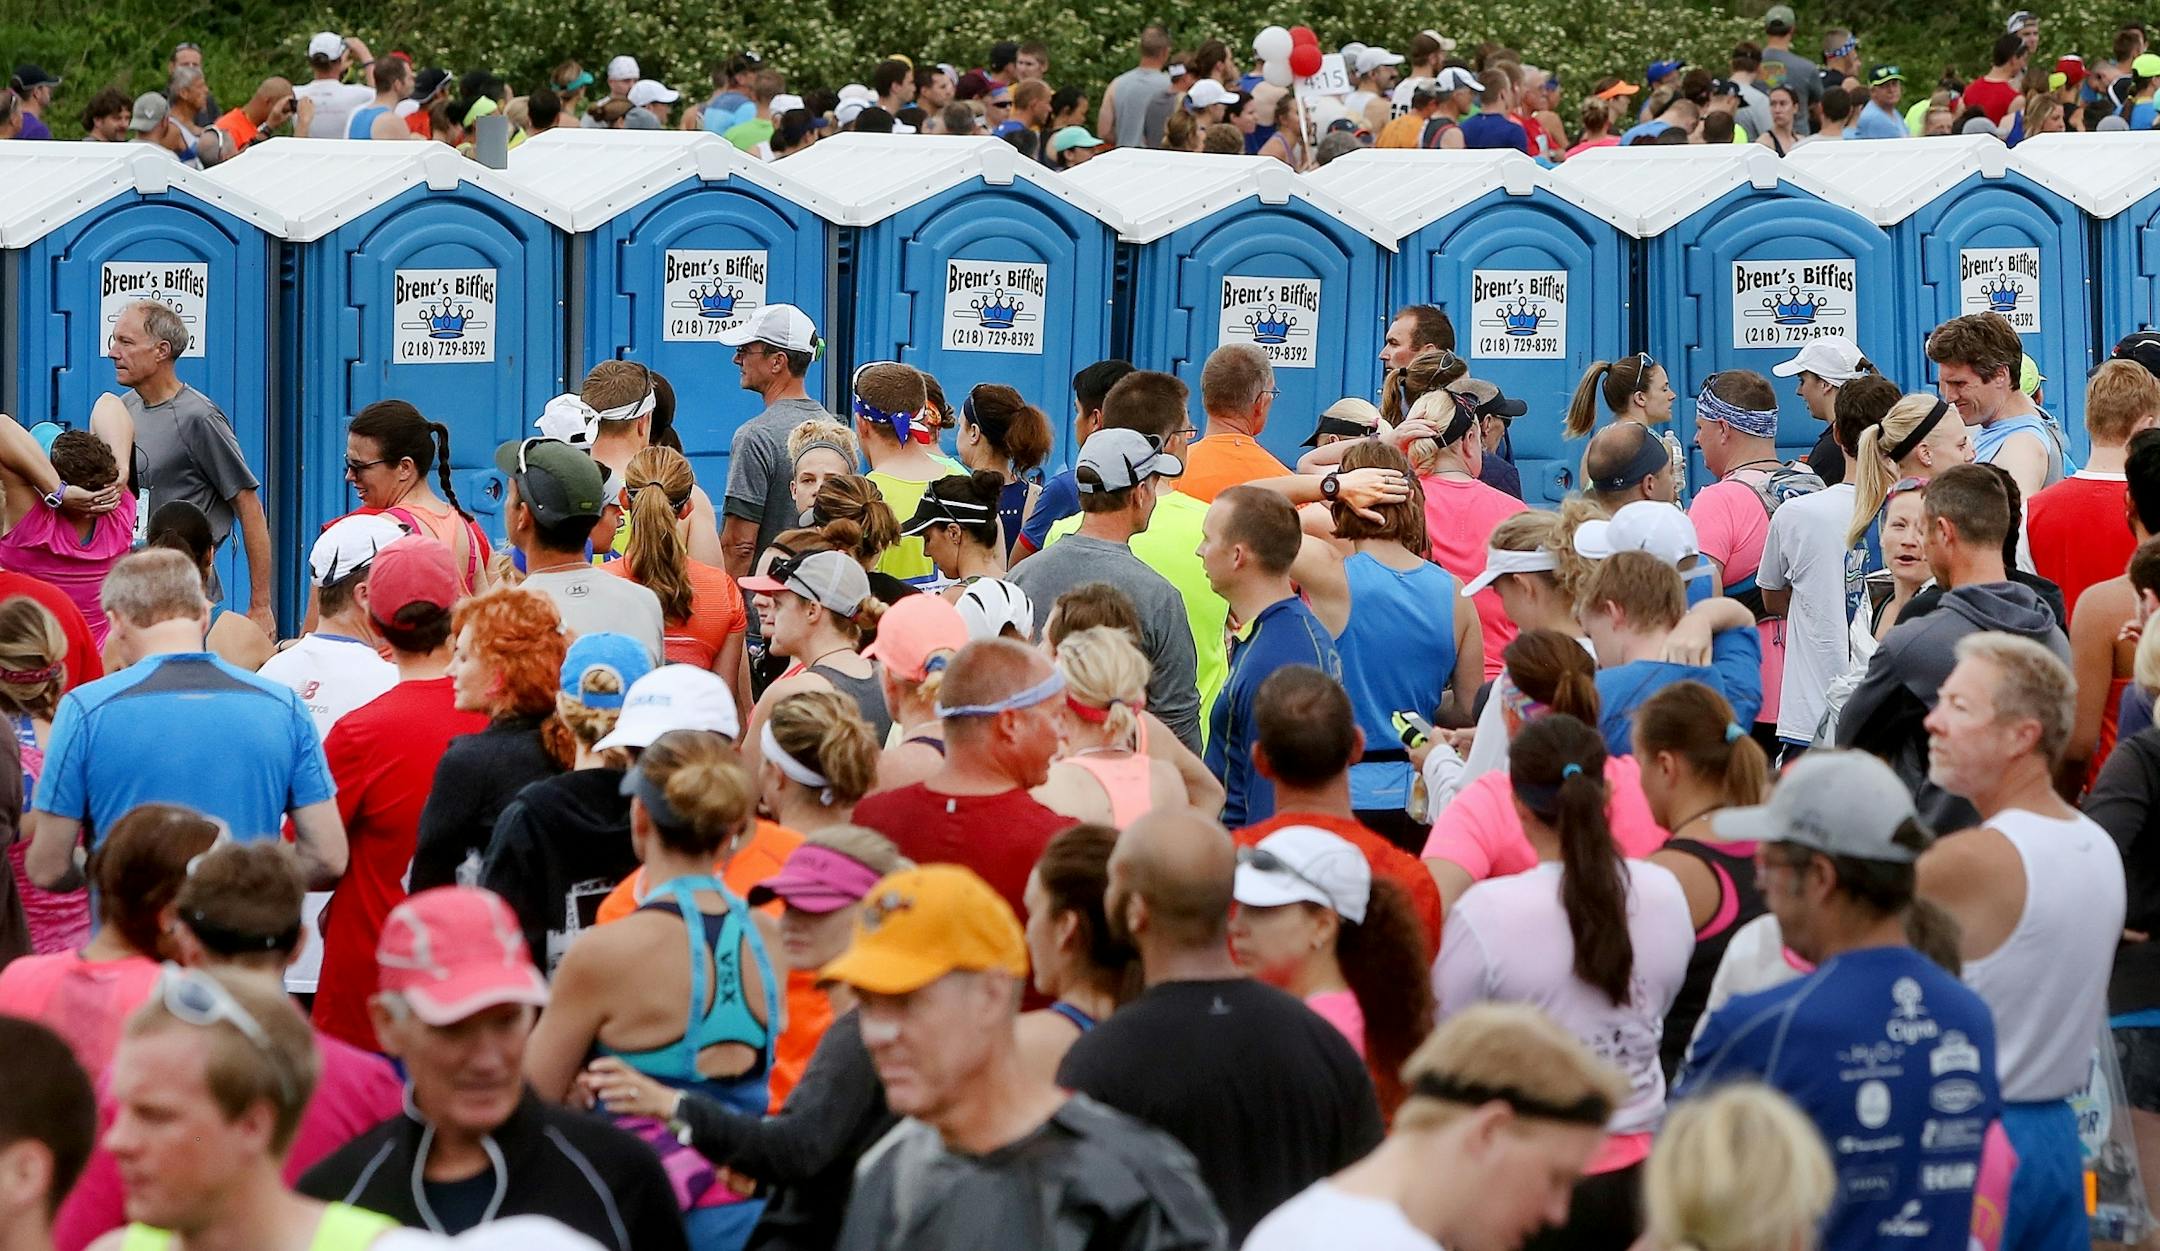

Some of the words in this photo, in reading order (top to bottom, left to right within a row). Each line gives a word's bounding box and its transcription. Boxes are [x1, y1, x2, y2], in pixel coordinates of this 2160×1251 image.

[1304, 70, 1344, 89] 4:15
[103, 266, 158, 298] Brent's
[165, 267, 204, 298] Biffies
[667, 254, 720, 284] Brent's
[726, 255, 764, 285] Biffies
[948, 263, 1001, 294] Brent's
[1007, 267, 1044, 297] Biffies
[1736, 265, 1795, 295] Brent's
[1803, 263, 1853, 292] Biffies
[1961, 253, 2003, 282] Brent's
[2008, 252, 2037, 280] Biffies
[396, 274, 449, 305] Brent's
[455, 273, 494, 304] Biffies
[1223, 280, 1274, 310] Brent's
[1280, 283, 1318, 312] Biffies
[1474, 274, 1524, 304] Brent's
[1530, 274, 1565, 304] Biffies
[671, 320, 703, 336] (218)
[2002, 313, 2033, 327] 9-8392
[402, 341, 434, 358] (218)
[438, 341, 486, 355] 729-8392
[952, 328, 983, 347] (218)
[987, 331, 1035, 346] 729-8392
[1480, 338, 1510, 354] (218)
[1514, 338, 1557, 352] 729-8392
[1745, 327, 1780, 344] (218)
